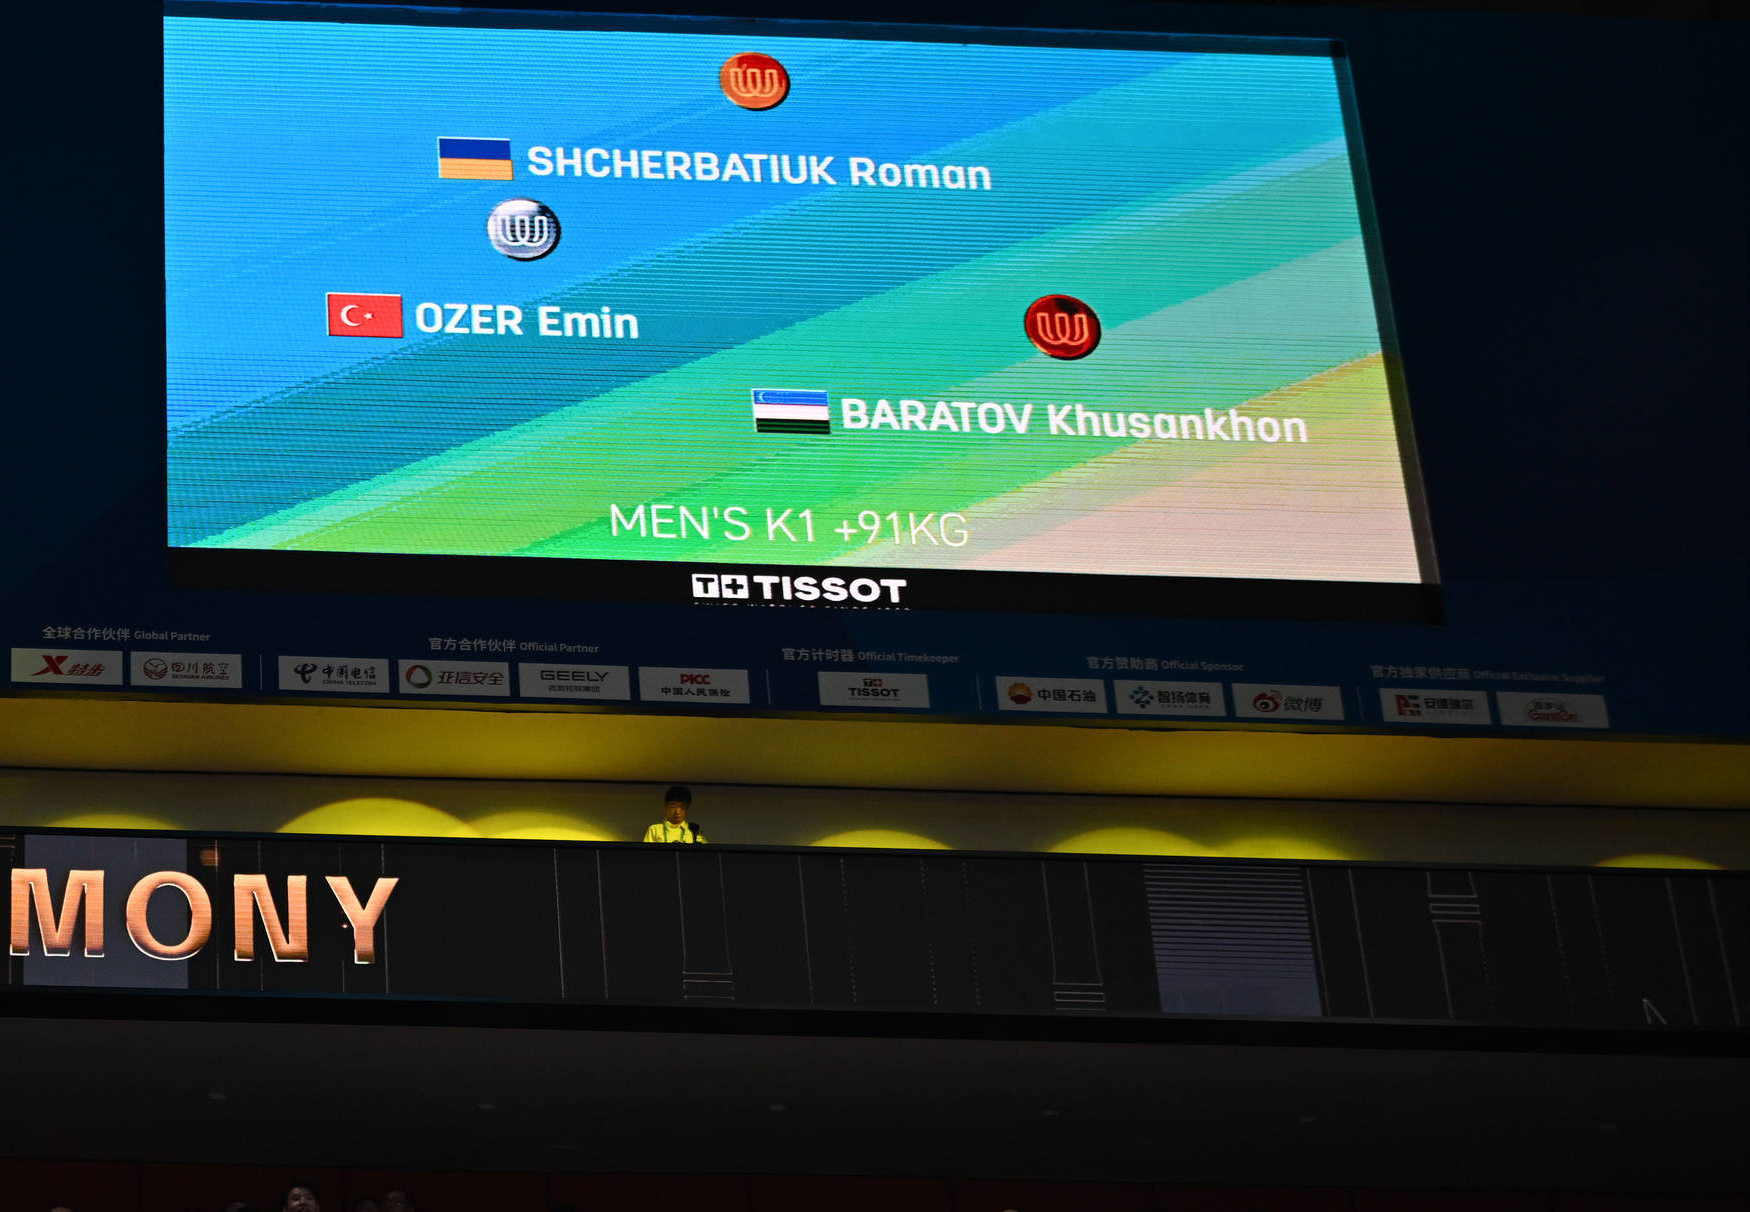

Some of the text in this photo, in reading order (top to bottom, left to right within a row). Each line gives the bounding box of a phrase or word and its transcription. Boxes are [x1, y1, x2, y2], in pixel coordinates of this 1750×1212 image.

[527, 145, 992, 191] SHCHERBATIUK Roman
[415, 300, 640, 341] OZER Emin
[841, 396, 1309, 444] BARATOV Khusankhon
[610, 502, 970, 548] MEN'S K1 +91KG
[752, 574, 907, 604] TISSOT
[42, 625, 211, 642] 全球合作伙伴 Global Partner
[427, 636, 600, 654] 官方合作伙伴 Official Partner
[857, 651, 896, 662] Official
[897, 652, 960, 665] Timekeeper
[321, 664, 377, 680] 中国电信
[437, 670, 505, 687] 亚信安全
[540, 670, 609, 683] GEELY
[848, 687, 900, 698] TISSOT
